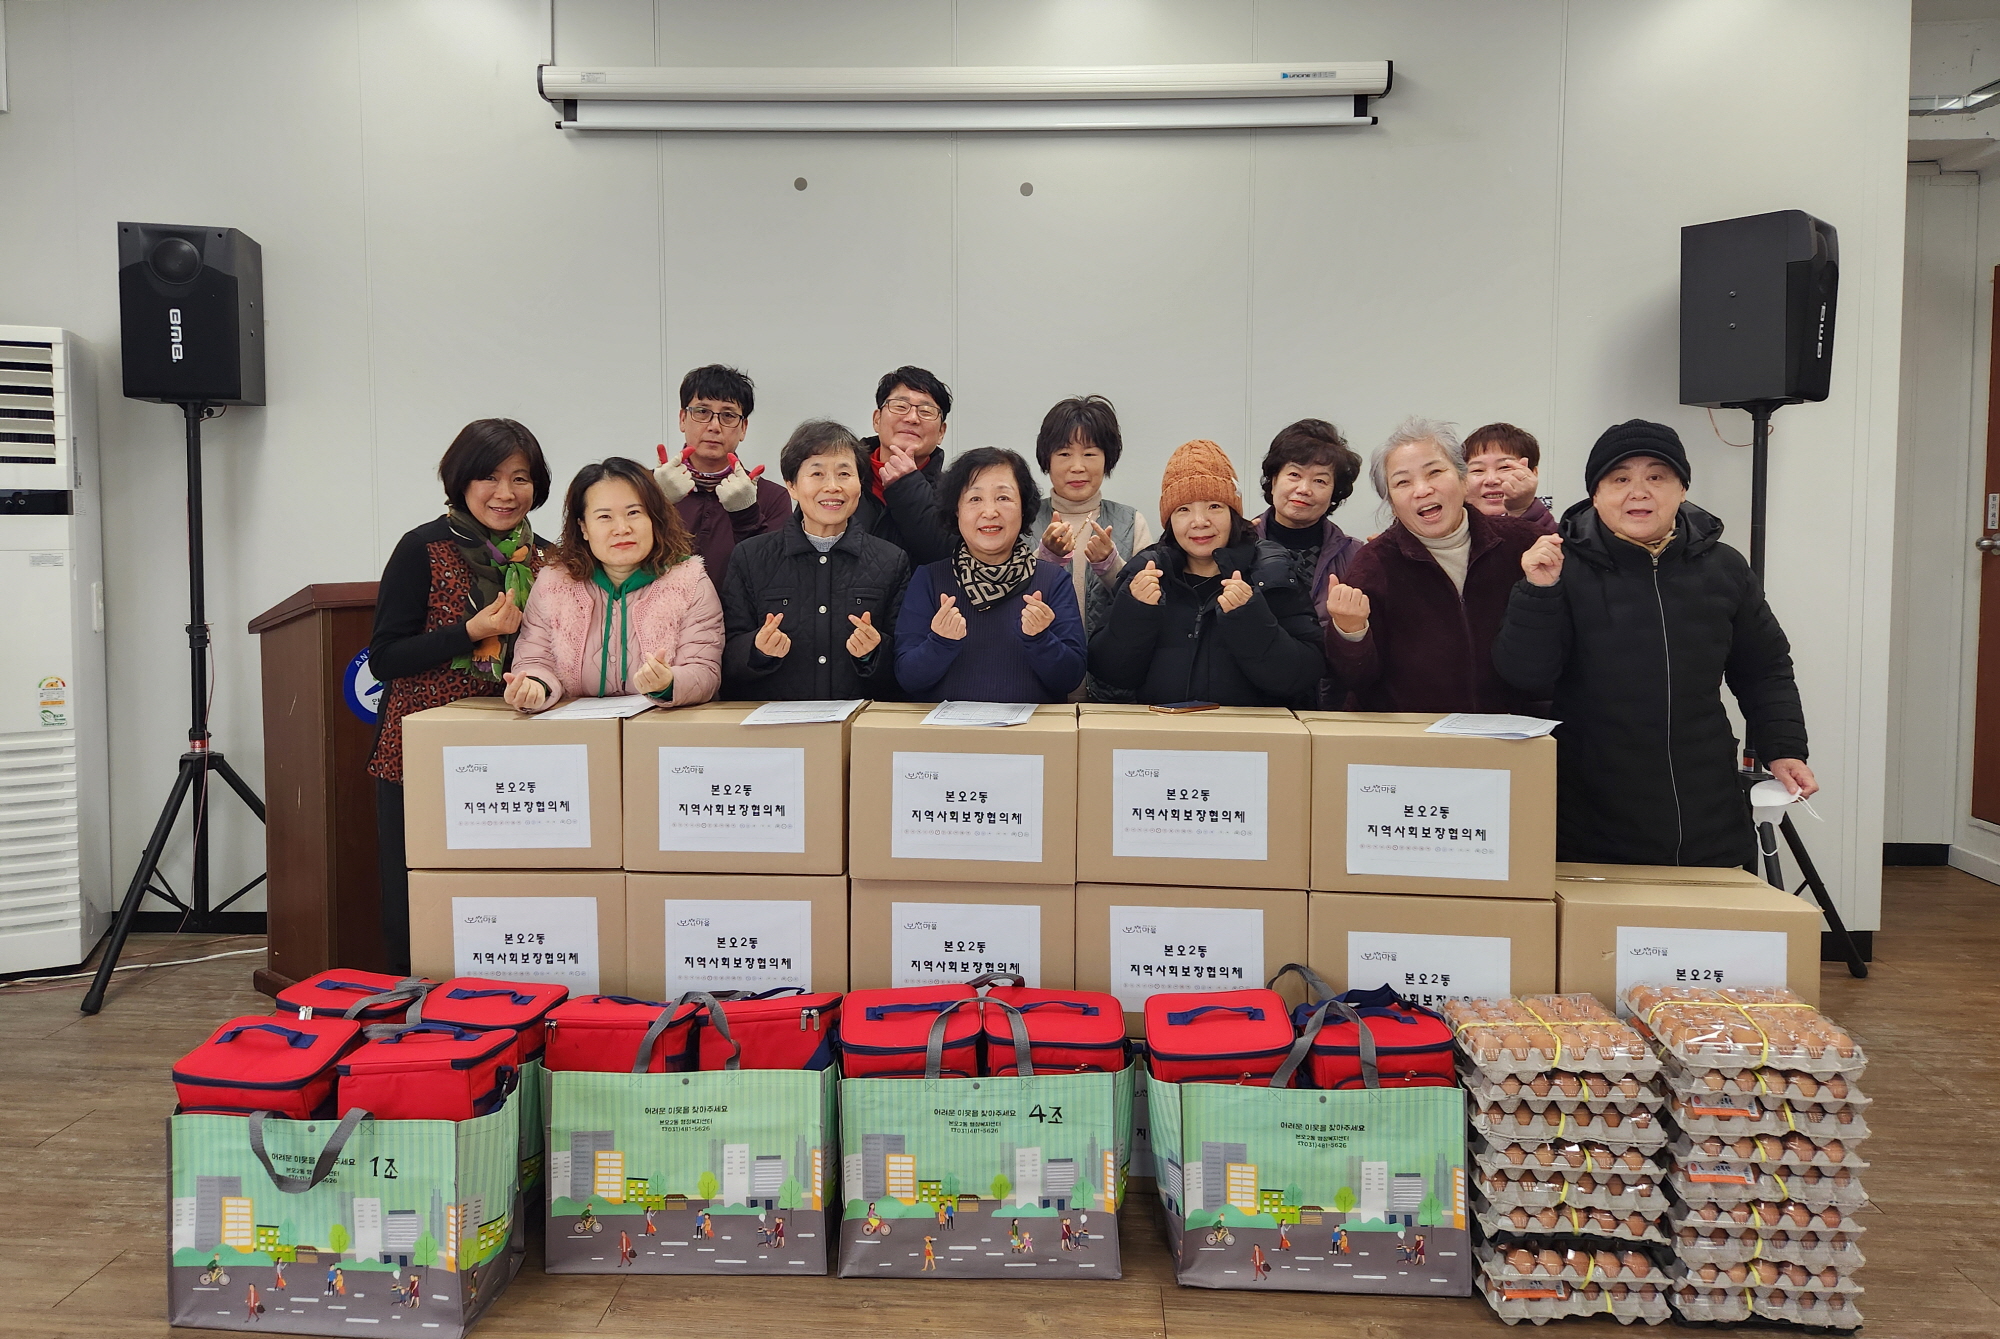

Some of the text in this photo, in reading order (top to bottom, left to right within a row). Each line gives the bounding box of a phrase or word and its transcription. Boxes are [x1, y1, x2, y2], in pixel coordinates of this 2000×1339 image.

[495, 781, 537, 794] 본오2동
[711, 784, 752, 797] 본오2동
[945, 790, 988, 804] 본오2동
[1166, 788, 1210, 802] 본오2동
[464, 800, 570, 814] 지역사회보장협의체
[678, 803, 786, 817] 지역사회보장협의체
[1403, 804, 1450, 820] 본오2동
[911, 809, 1022, 825] 지역사회보장협의체
[1132, 807, 1245, 824] 지역사회보장협의체
[1367, 824, 1487, 842] 지역사회보장협의체
[504, 933, 545, 945] 본오2동
[716, 936, 758, 950] 본오2동
[943, 940, 986, 954] 본오2동
[1163, 944, 1208, 959] 본오2동
[472, 952, 579, 965] 지역사회보장협의체
[684, 956, 792, 970] 지역사회보장협의체
[911, 960, 1020, 975] 지역사회보장협의체
[1130, 964, 1243, 979] 지역사회보장협의체
[1404, 972, 1451, 987] 본오2동
[1675, 968, 1724, 984] 본오2동
[644, 1105, 728, 1115] 어려운 이웃을 찾아주세요
[934, 1108, 1017, 1118] 어려운 이웃을 찾아주세요
[1028, 1104, 1063, 1124] 4조
[1280, 1122, 1366, 1132] 어려운 이웃을 찾아주세요
[272, 1153, 292, 1162] 어려운
[294, 1155, 316, 1165] 이웃을
[369, 1155, 399, 1180] 1조
